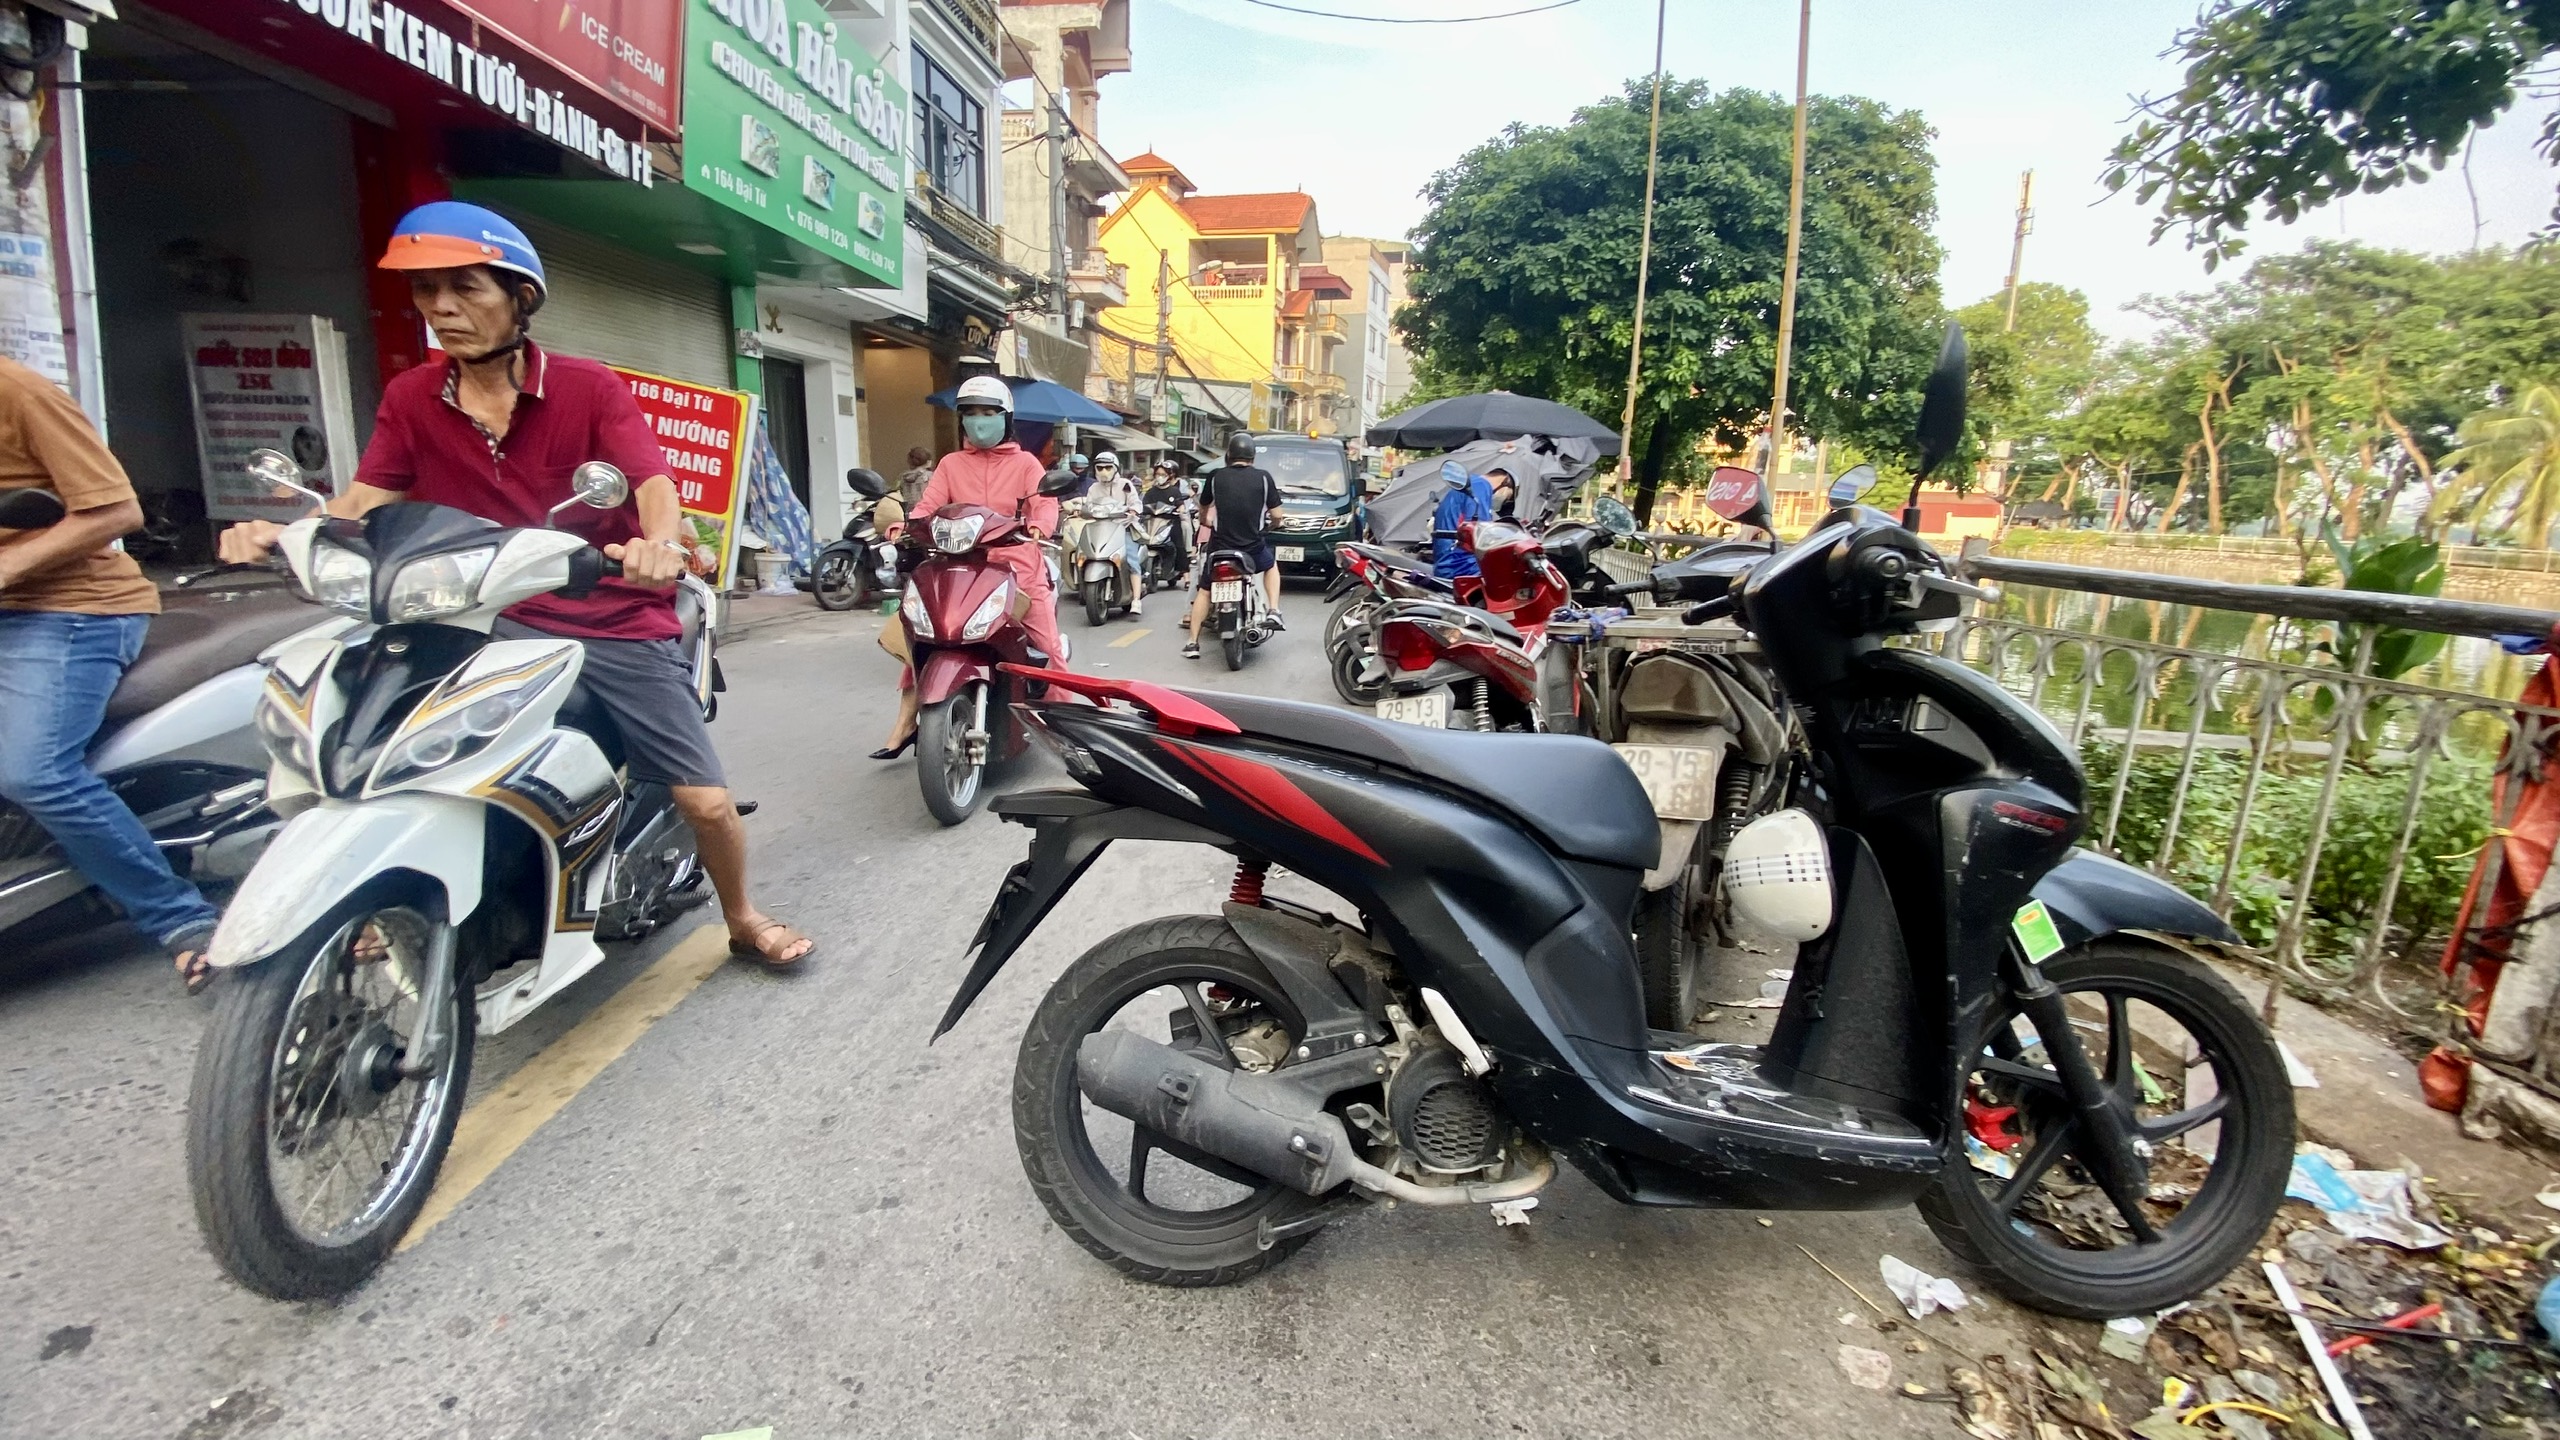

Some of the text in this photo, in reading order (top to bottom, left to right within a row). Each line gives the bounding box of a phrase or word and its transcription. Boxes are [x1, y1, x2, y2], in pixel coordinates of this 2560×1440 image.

[581, 11, 665, 87] ICE CREAM
[711, 41, 785, 112] CHUYÊN
[795, 22, 854, 115] HẢI
[853, 68, 905, 157] SẢN
[714, 166, 734, 192] 164
[735, 176, 753, 204] Đại
[797, 210, 813, 232] 076
[830, 228, 849, 251] 1234
[629, 379, 714, 413] 166 Đại Từ
[656, 415, 731, 450] NƯỚNG
[678, 479, 704, 504] ỤI
[1215, 591, 1238, 601] 7326
[1385, 697, 1434, 721] 29-Y3
[1623, 748, 1700, 780] 29-Y5
